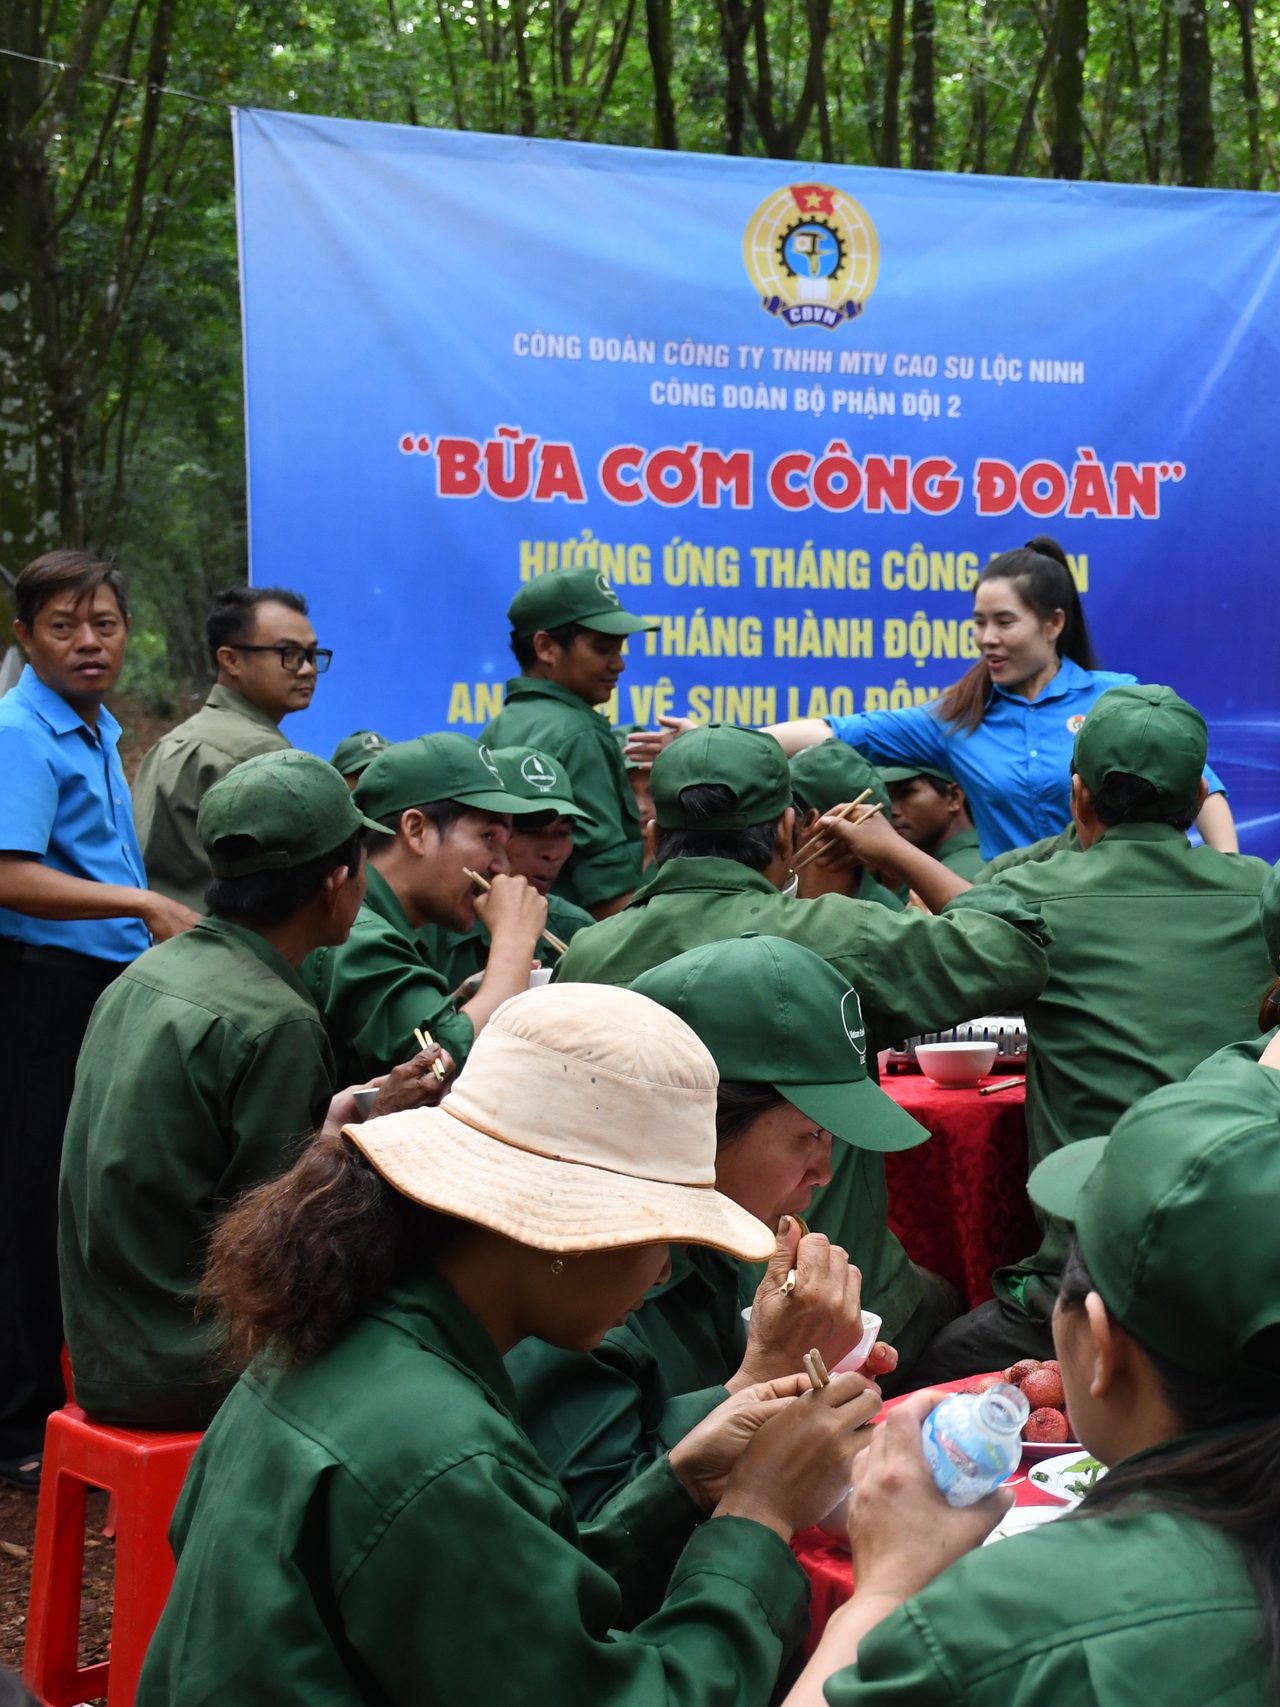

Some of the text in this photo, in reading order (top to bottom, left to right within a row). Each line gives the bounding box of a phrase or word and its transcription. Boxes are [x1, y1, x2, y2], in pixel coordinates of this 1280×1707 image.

[513, 329, 1085, 386] CÔNG ĐOÀN CÔNG TY TNHH MTV CAO SU LỘC NINH
[650, 377, 962, 422] CÔNG ĐOÀN BỘ PHẬN ĐỘI 2
[598, 442, 753, 509] CƠM
[767, 438, 963, 516] CÔNG
[519, 528, 979, 593] HƯỞNG ỨNG THÁNG CÔNG
[640, 606, 764, 659] THÁNG
[773, 608, 873, 659] HÀNH
[883, 610, 981, 668] ĐỘNG
[447, 682, 504, 725] AN
[687, 685, 777, 727] SINH
